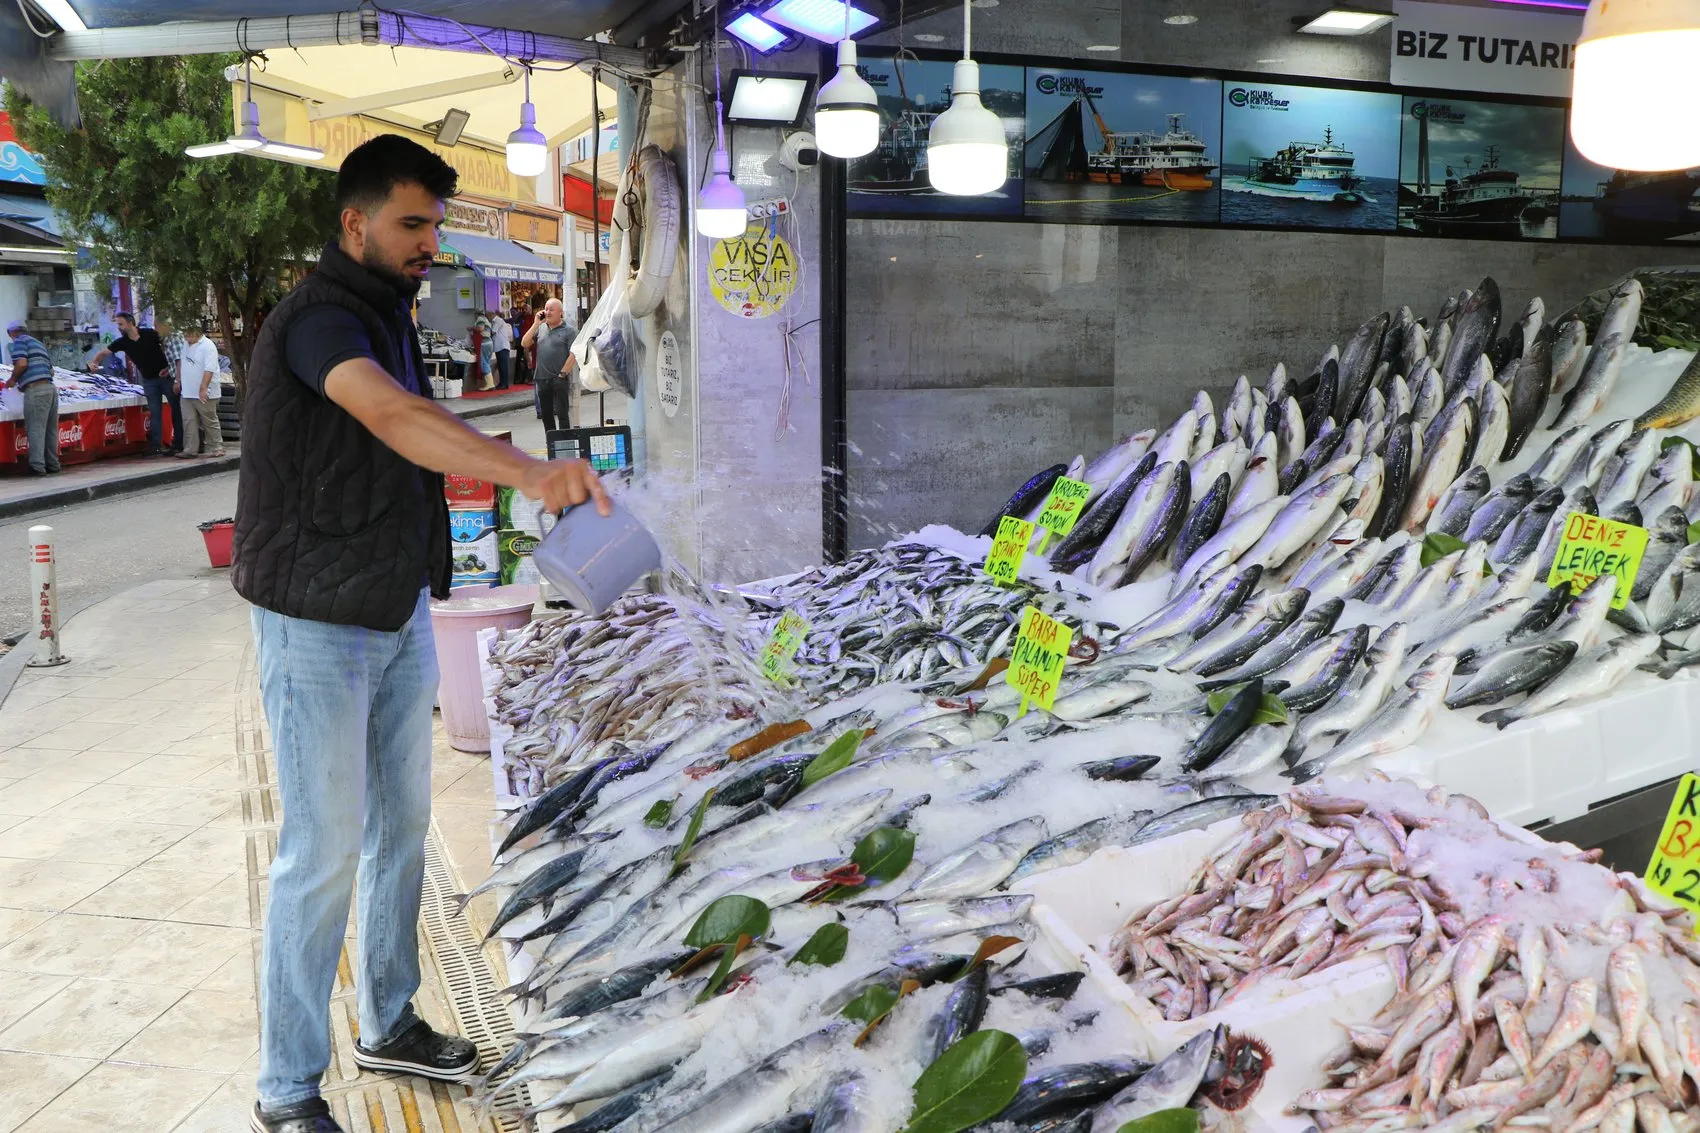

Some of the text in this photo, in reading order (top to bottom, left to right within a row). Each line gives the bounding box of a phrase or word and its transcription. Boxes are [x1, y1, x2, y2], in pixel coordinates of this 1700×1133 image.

[1557, 543, 1632, 581] LEVREK
[1013, 636, 1063, 676] PALAMUT
[1678, 779, 1700, 817] K
